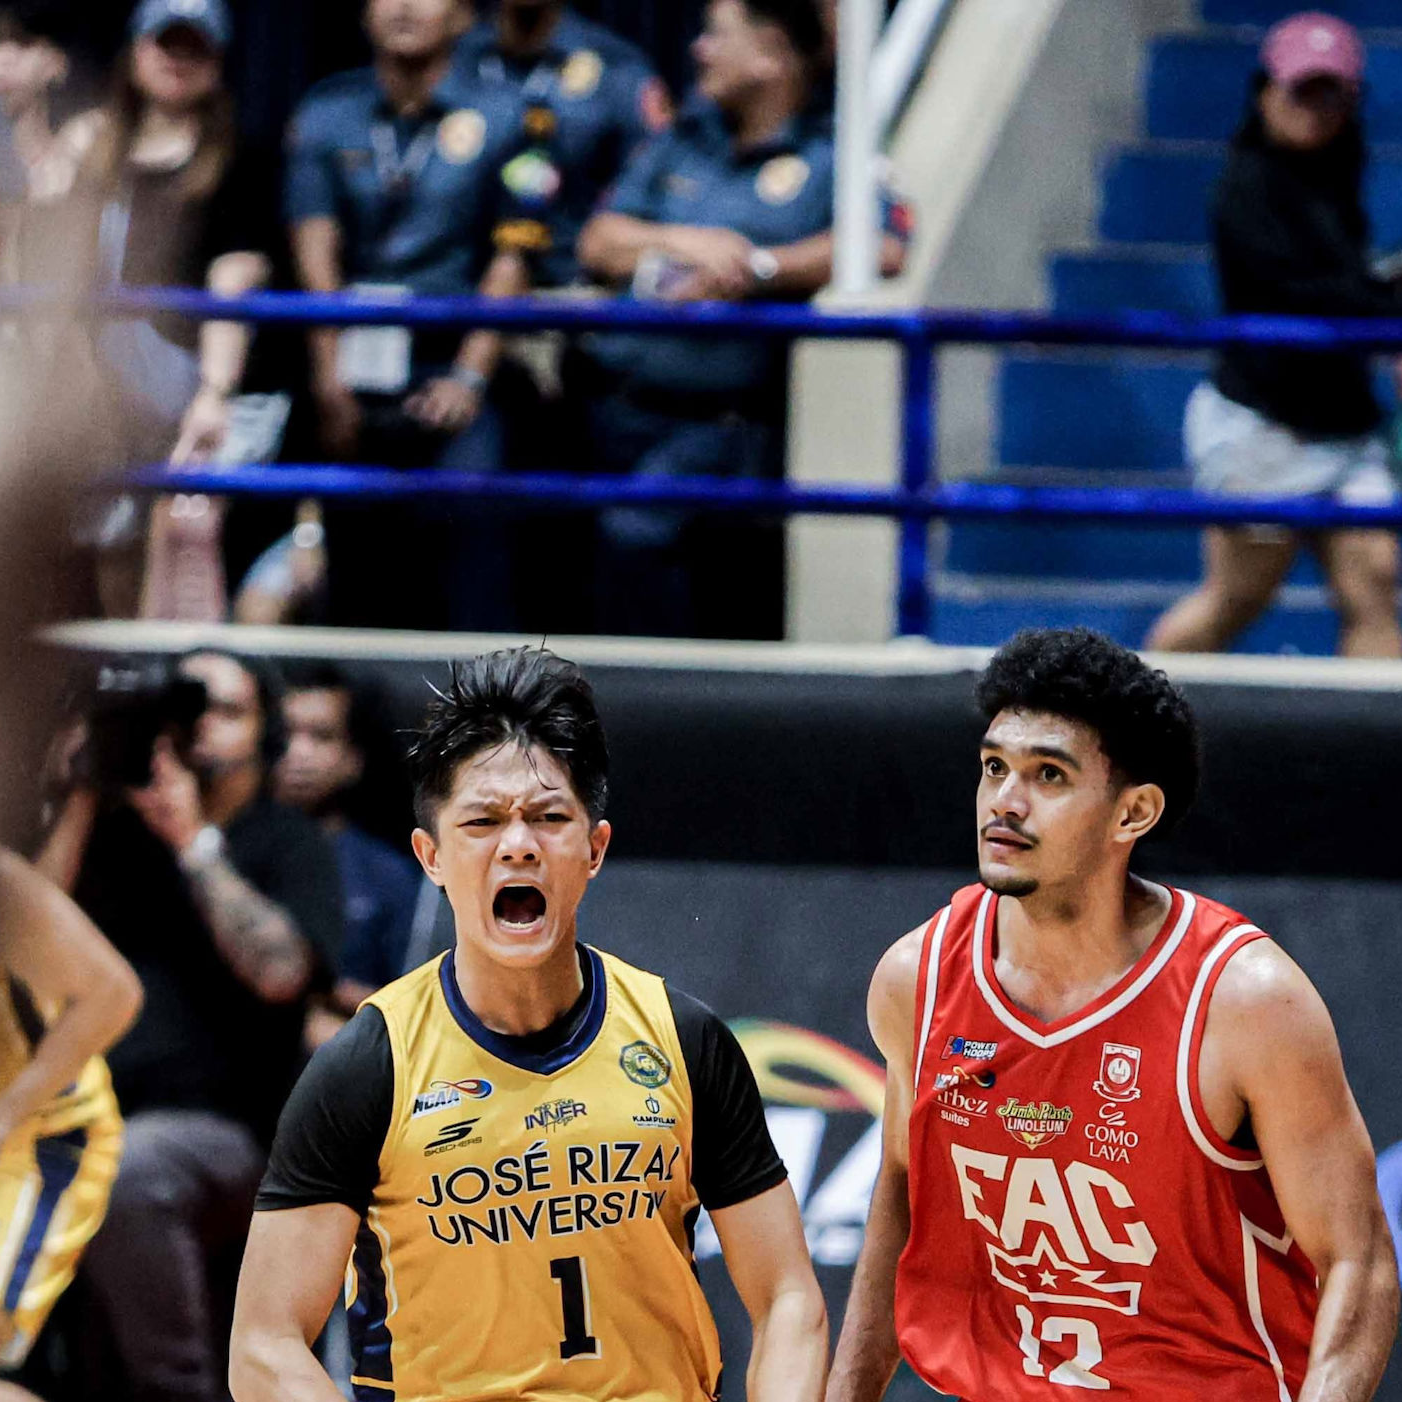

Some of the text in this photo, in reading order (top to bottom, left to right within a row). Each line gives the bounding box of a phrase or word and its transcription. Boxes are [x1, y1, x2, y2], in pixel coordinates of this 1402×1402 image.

[1007, 1117, 1064, 1133] LINOLEUM
[1084, 1123, 1139, 1148] COMO
[1089, 1141, 1130, 1164] LAYA
[416, 1140, 551, 1208] JOSÉ
[950, 1143, 1158, 1267] EAC
[428, 1190, 667, 1246] UNIVERSITY
[550, 1256, 599, 1361] 1
[1016, 1304, 1110, 1390] 12
